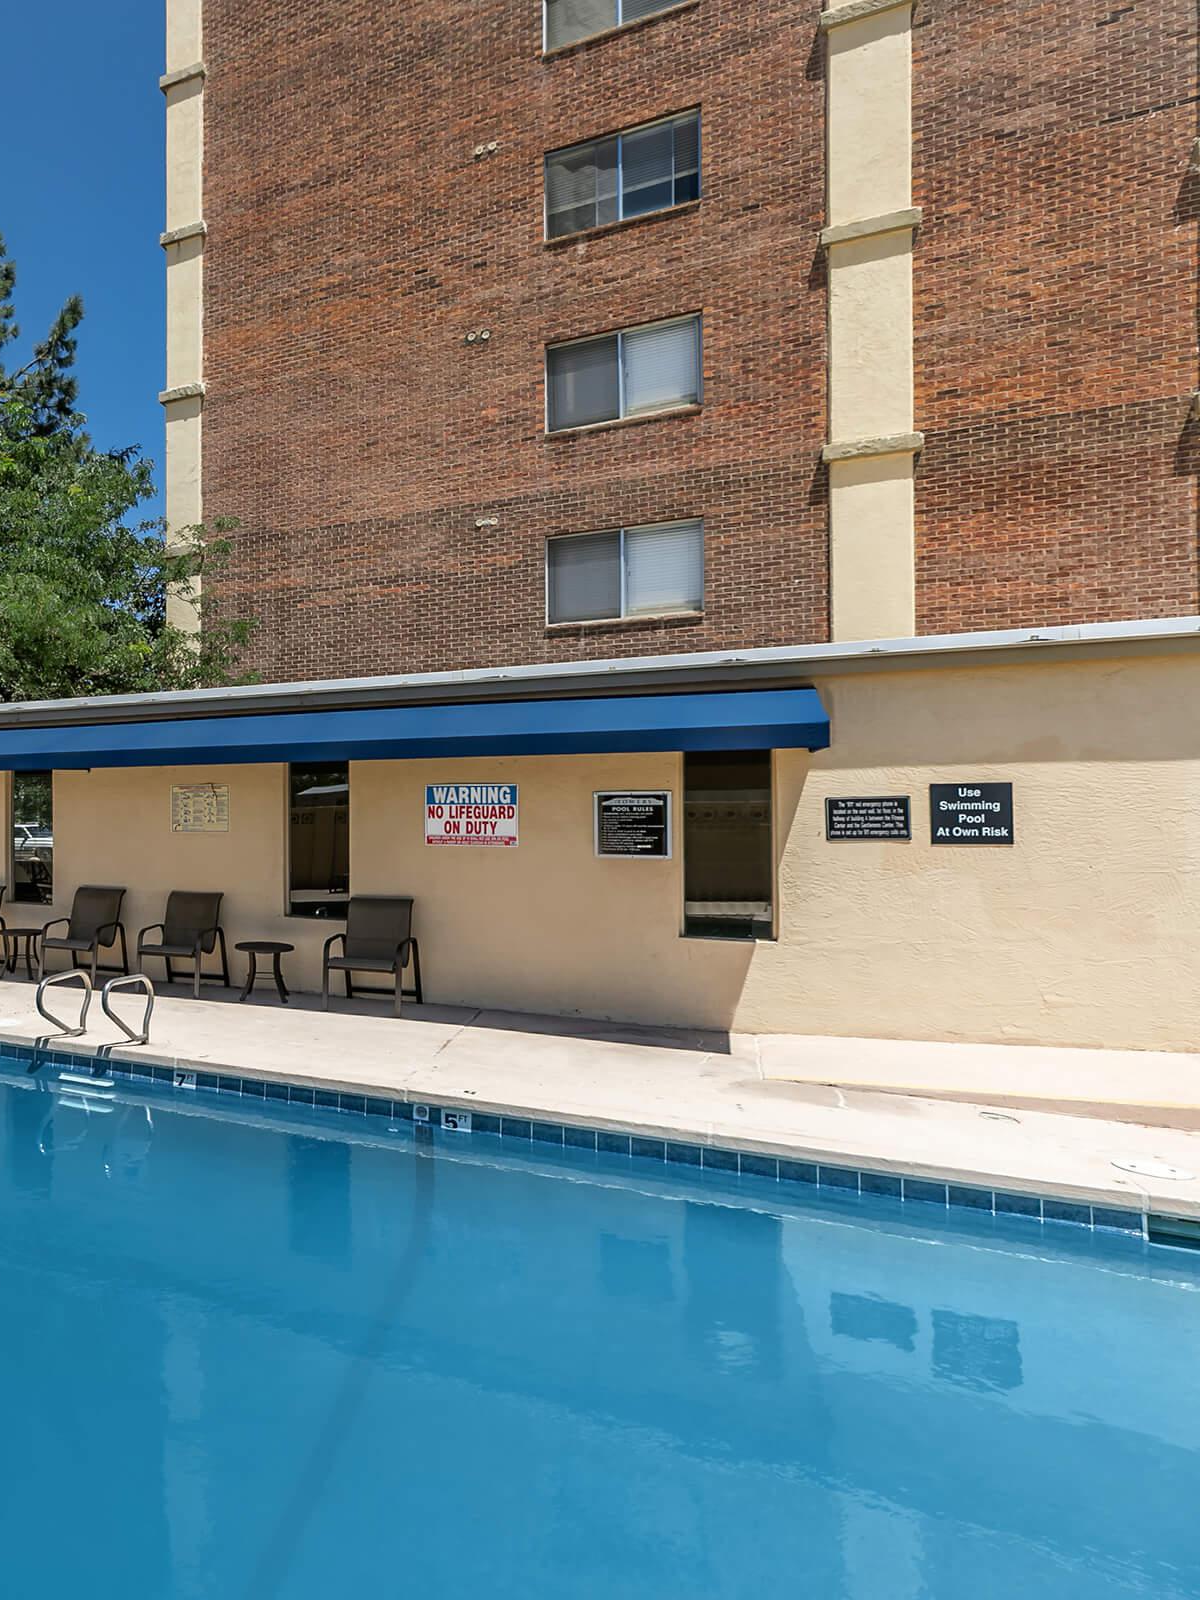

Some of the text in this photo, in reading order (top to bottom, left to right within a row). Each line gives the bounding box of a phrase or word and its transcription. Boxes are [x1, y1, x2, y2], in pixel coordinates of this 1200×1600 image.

[432, 786, 511, 804] WARNING
[958, 787, 981, 798] Use
[427, 805, 515, 819] NO LIFEGUARD
[939, 800, 1001, 813] Swimming
[958, 813, 985, 824] Pool
[444, 820, 498, 834] ON DUTY
[936, 826, 1009, 837] At Own Risk
[175, 1072, 187, 1086] 7
[444, 1112, 468, 1129] 5 FT
